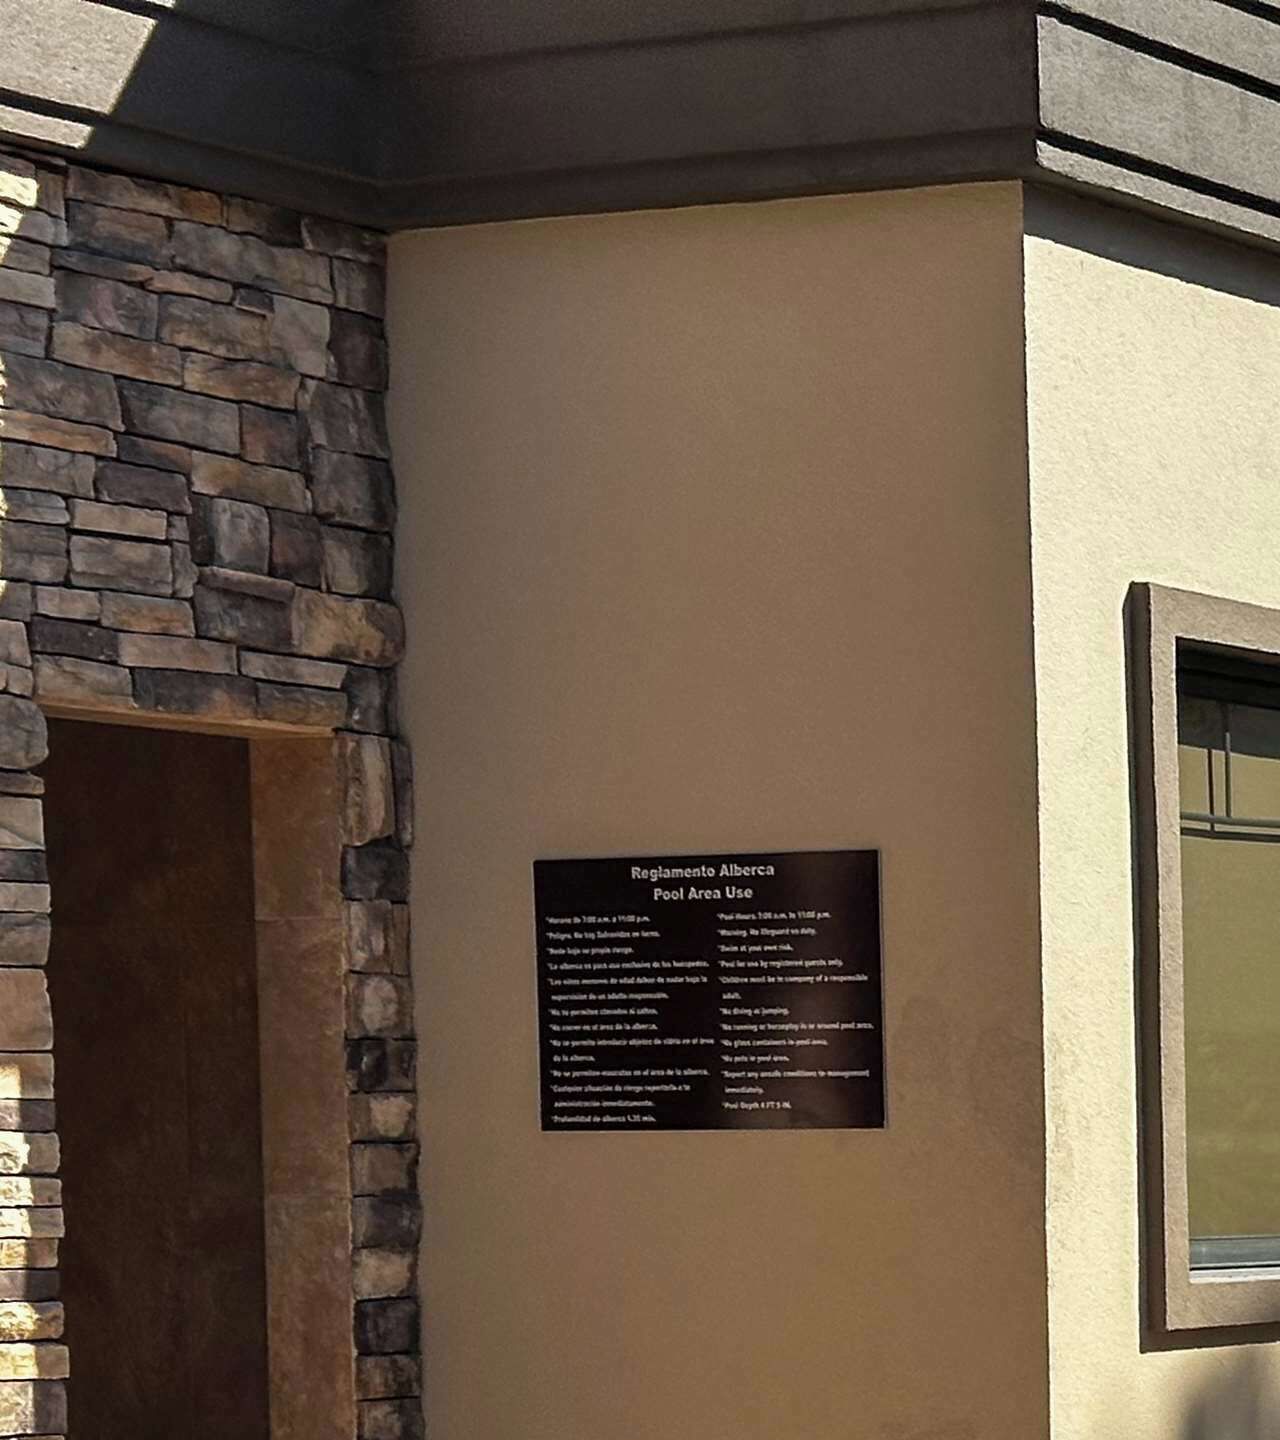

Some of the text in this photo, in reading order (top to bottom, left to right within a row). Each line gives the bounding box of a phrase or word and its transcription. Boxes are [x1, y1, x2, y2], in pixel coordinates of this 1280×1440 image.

[631, 863, 775, 882] Reglamento Alberca
[653, 885, 753, 901] Pool Area Use
